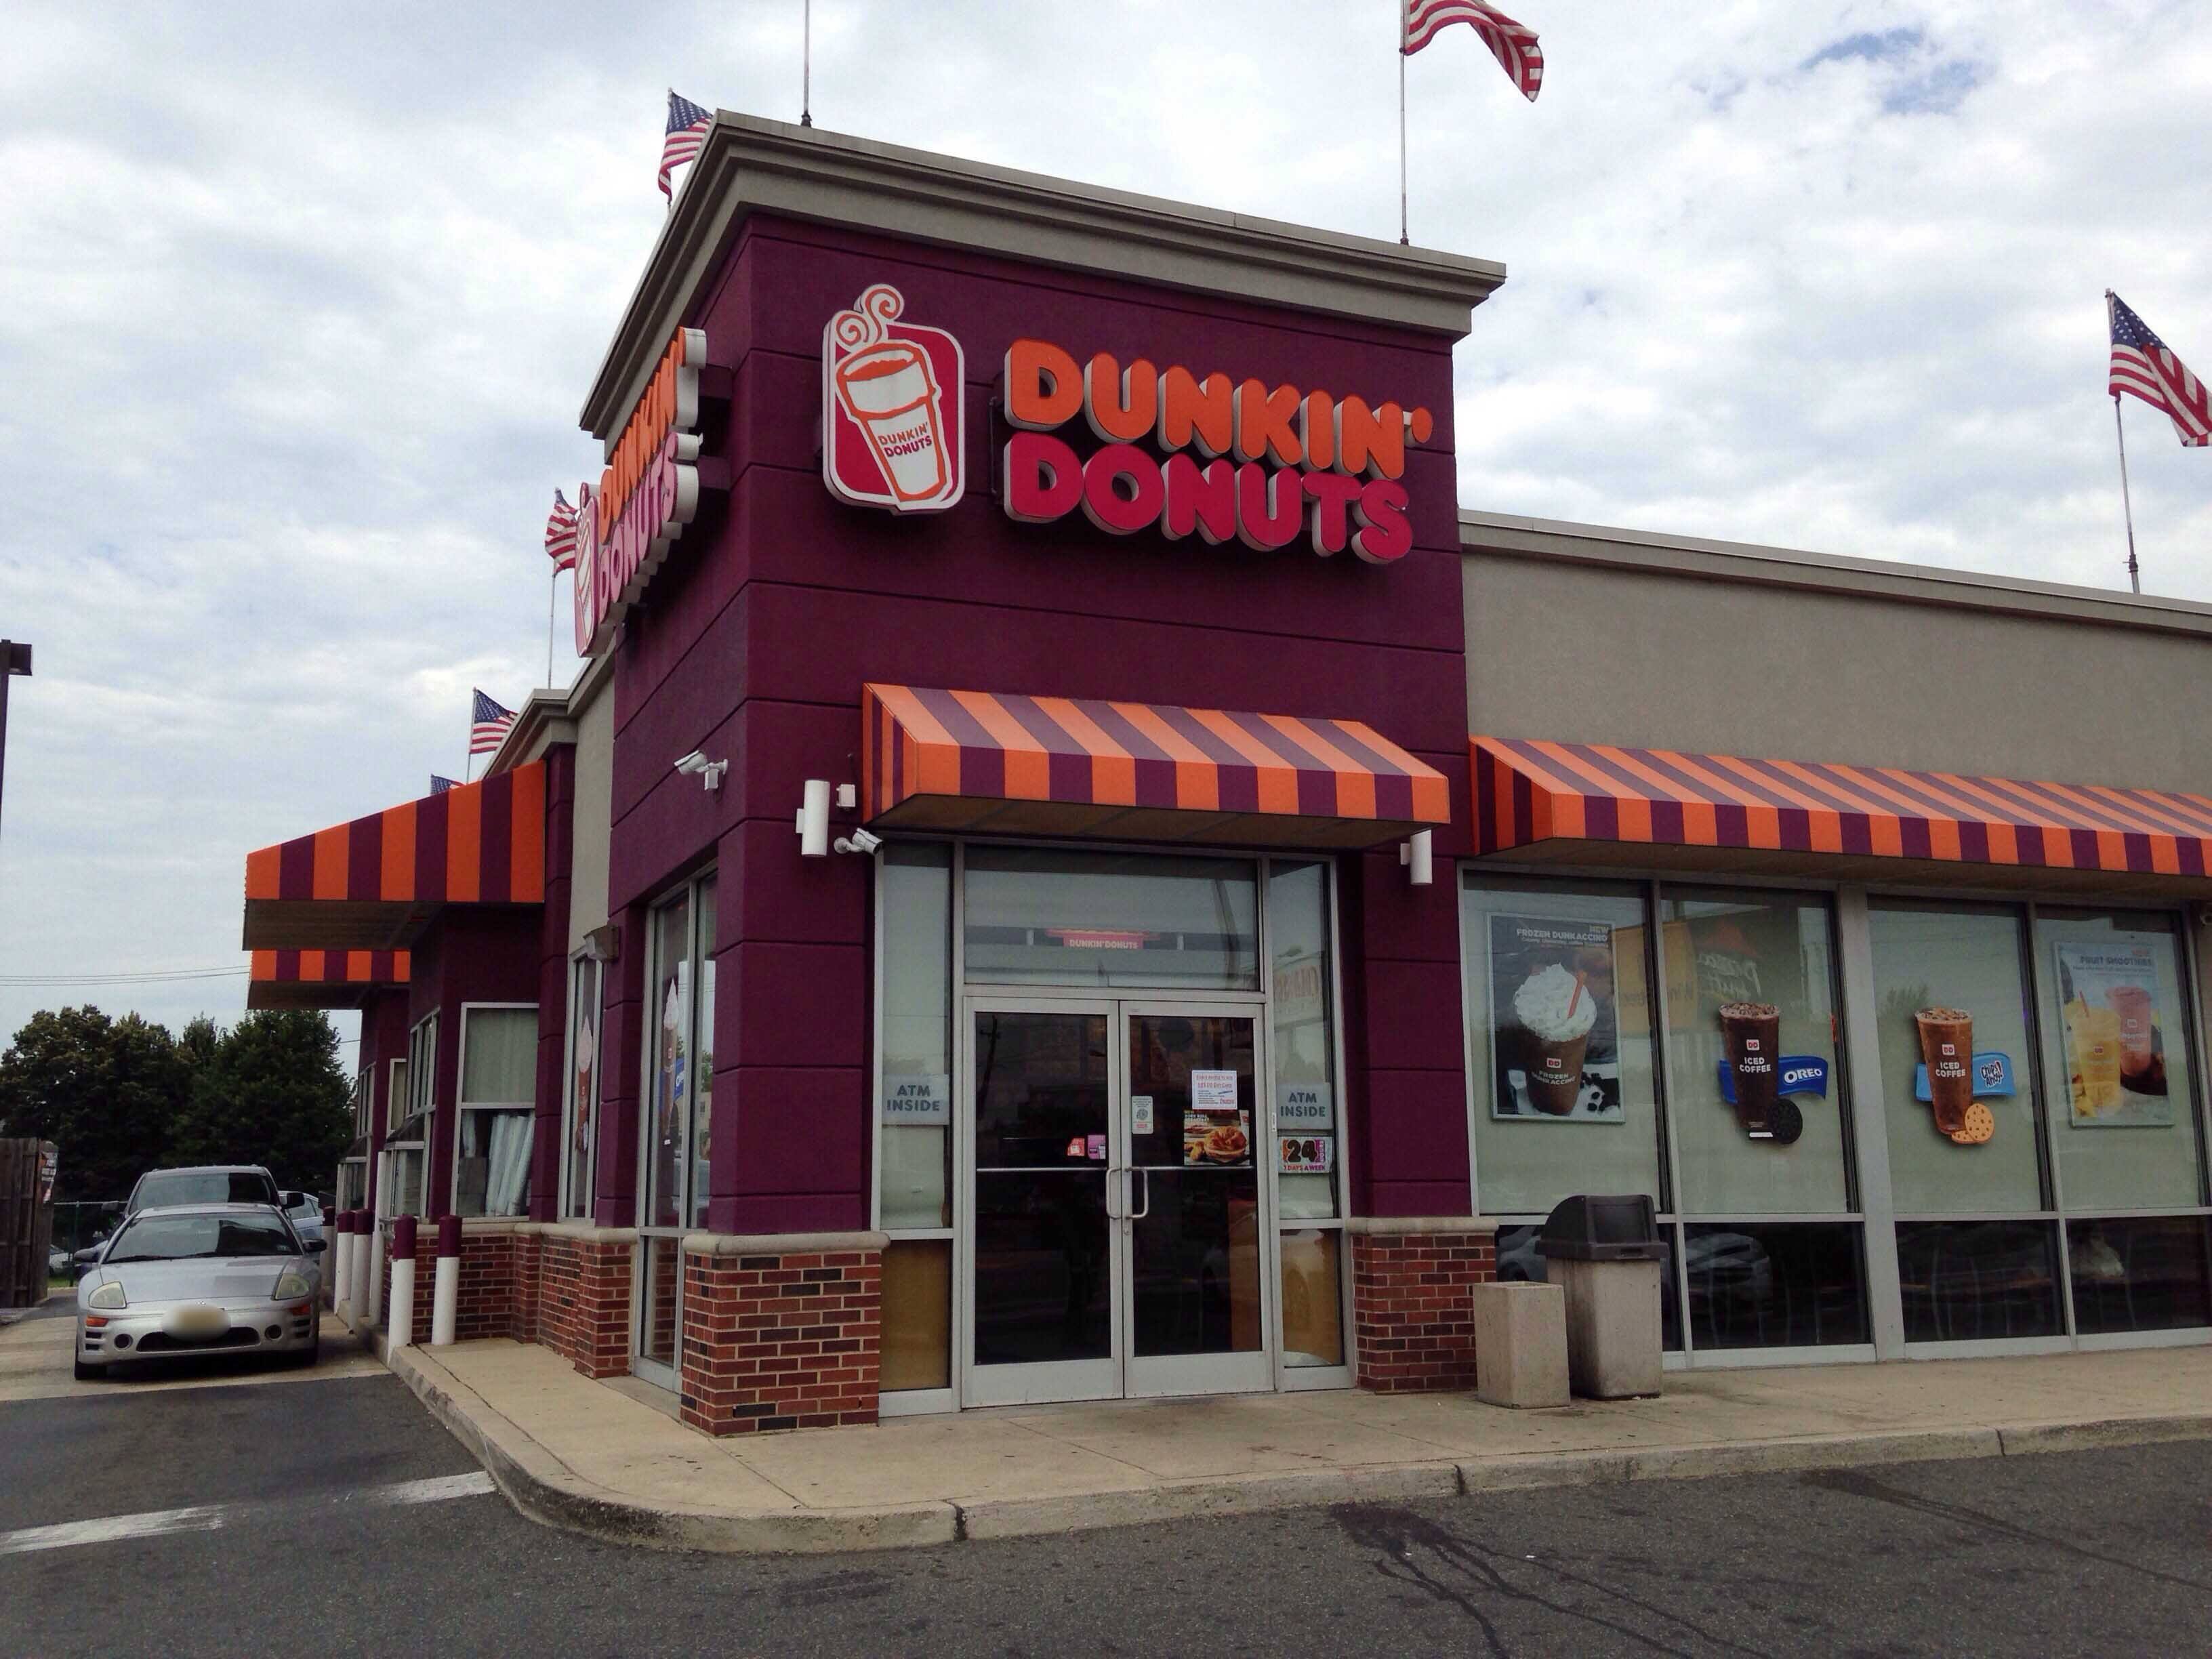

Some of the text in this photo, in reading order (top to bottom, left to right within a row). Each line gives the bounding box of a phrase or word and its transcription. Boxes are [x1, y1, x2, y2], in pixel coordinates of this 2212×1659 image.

[1006, 337, 1433, 480] DUNKIN'
[878, 422, 928, 445] DUNKIN'
[884, 435, 932, 457] DONUTS
[1006, 431, 1413, 563] DONUTS
[1517, 928, 1551, 938] FROZEN
[1739, 1064, 1771, 1073] COFFEE
[1936, 1069, 1966, 1078] COFFEE
[1784, 1068, 1822, 1084] OREO
[897, 1084, 930, 1097] ATM
[1288, 1092, 1317, 1103] ATM
[886, 1099, 940, 1111] INSIDE
[1280, 1105, 1326, 1118] INSIDE
[1287, 1139, 1318, 1163] 24
